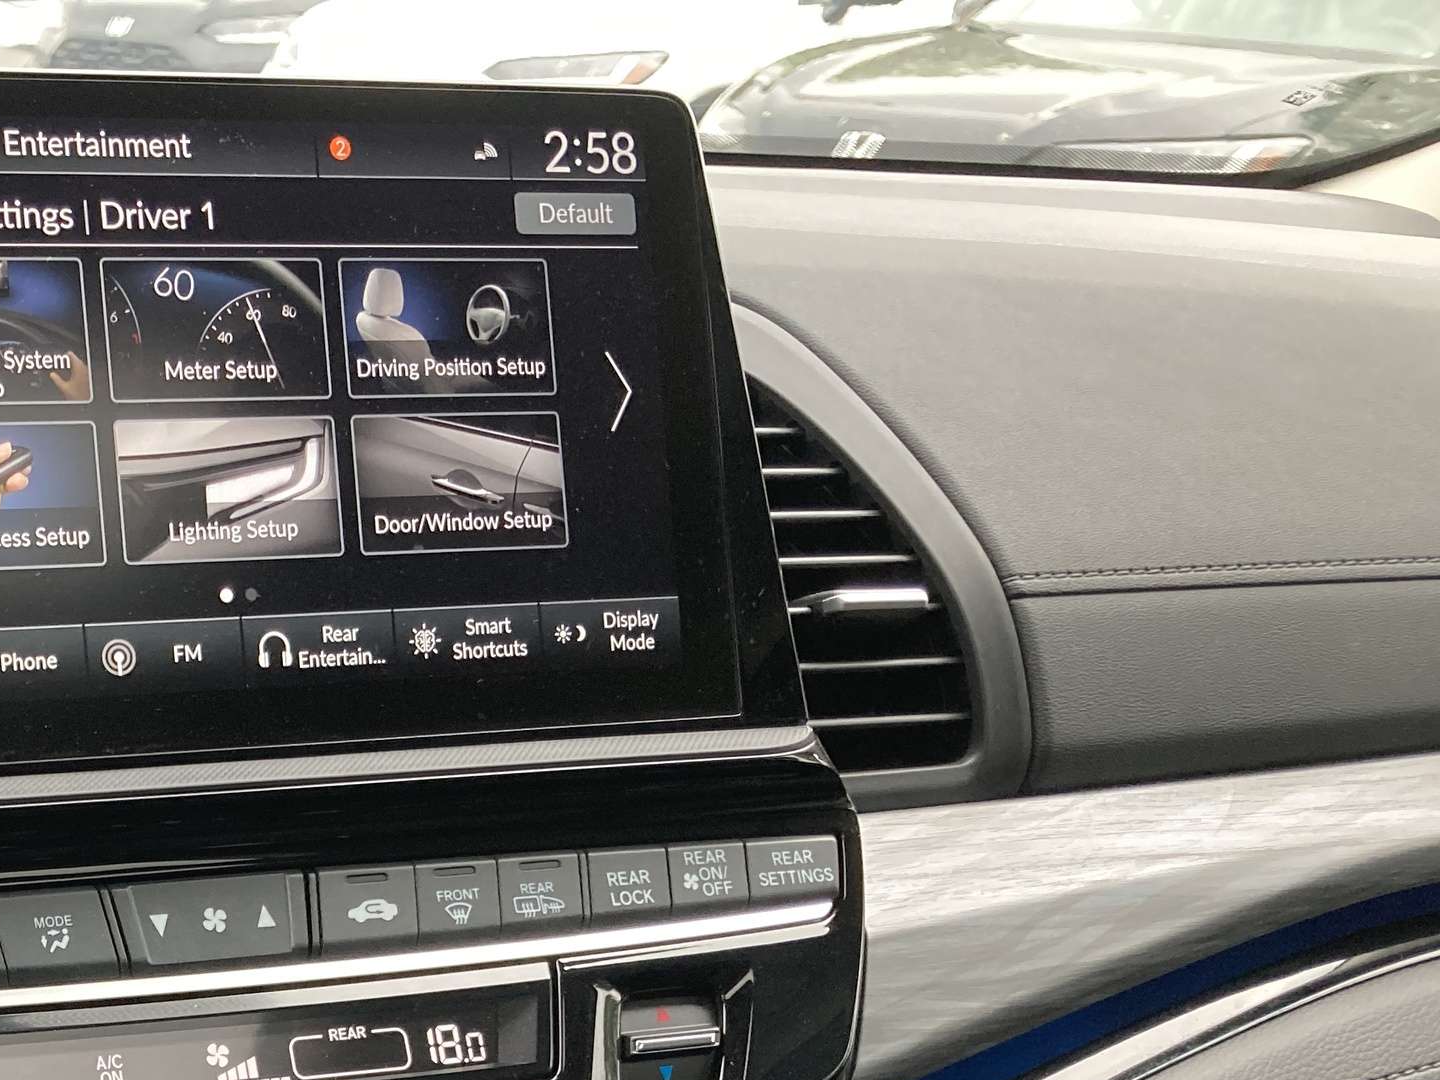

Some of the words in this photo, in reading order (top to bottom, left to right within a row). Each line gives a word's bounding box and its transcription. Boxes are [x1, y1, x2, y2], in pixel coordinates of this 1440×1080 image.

[4, 131, 191, 159] Entertainment
[335, 141, 346, 156] 2
[543, 130, 638, 175] 2:58
[101, 202, 191, 229] Driver
[201, 202, 216, 231] 1
[539, 202, 613, 225] Default
[153, 266, 195, 300] 60
[110, 311, 118, 323] 6
[281, 304, 297, 318] 80
[217, 332, 233, 344] 40
[3, 350, 71, 373] System
[164, 360, 222, 381] Meter
[225, 360, 278, 381] Setup
[356, 358, 419, 380] Driving
[424, 357, 493, 377] Position
[496, 357, 546, 378] Setup
[168, 521, 242, 543] Lighting
[247, 519, 299, 541] Setup
[374, 511, 500, 536] Door/Window
[504, 510, 552, 531] Setup
[36, 527, 90, 549] Setup
[464, 617, 512, 636] Smart
[603, 611, 658, 633] Display
[321, 625, 359, 644] Rear
[609, 633, 655, 652] Mode
[173, 644, 202, 662] FM
[298, 648, 387, 669] Entertain...
[452, 639, 528, 660] Shortcuts
[0, 650, 58, 672] Phone
[683, 850, 727, 865] REAR
[771, 851, 814, 866] REAR
[606, 870, 651, 886] REAR
[699, 866, 728, 881] ON/
[759, 866, 835, 885] SETTINGS
[436, 887, 481, 902] FRONT
[520, 882, 555, 894] REAR
[702, 878, 733, 897] OFF
[611, 889, 655, 907] LOCK
[33, 914, 73, 929] MODE
[328, 1025, 367, 1040] REAR
[426, 1023, 487, 1067] 18.0
[96, 1054, 124, 1070] A/C
